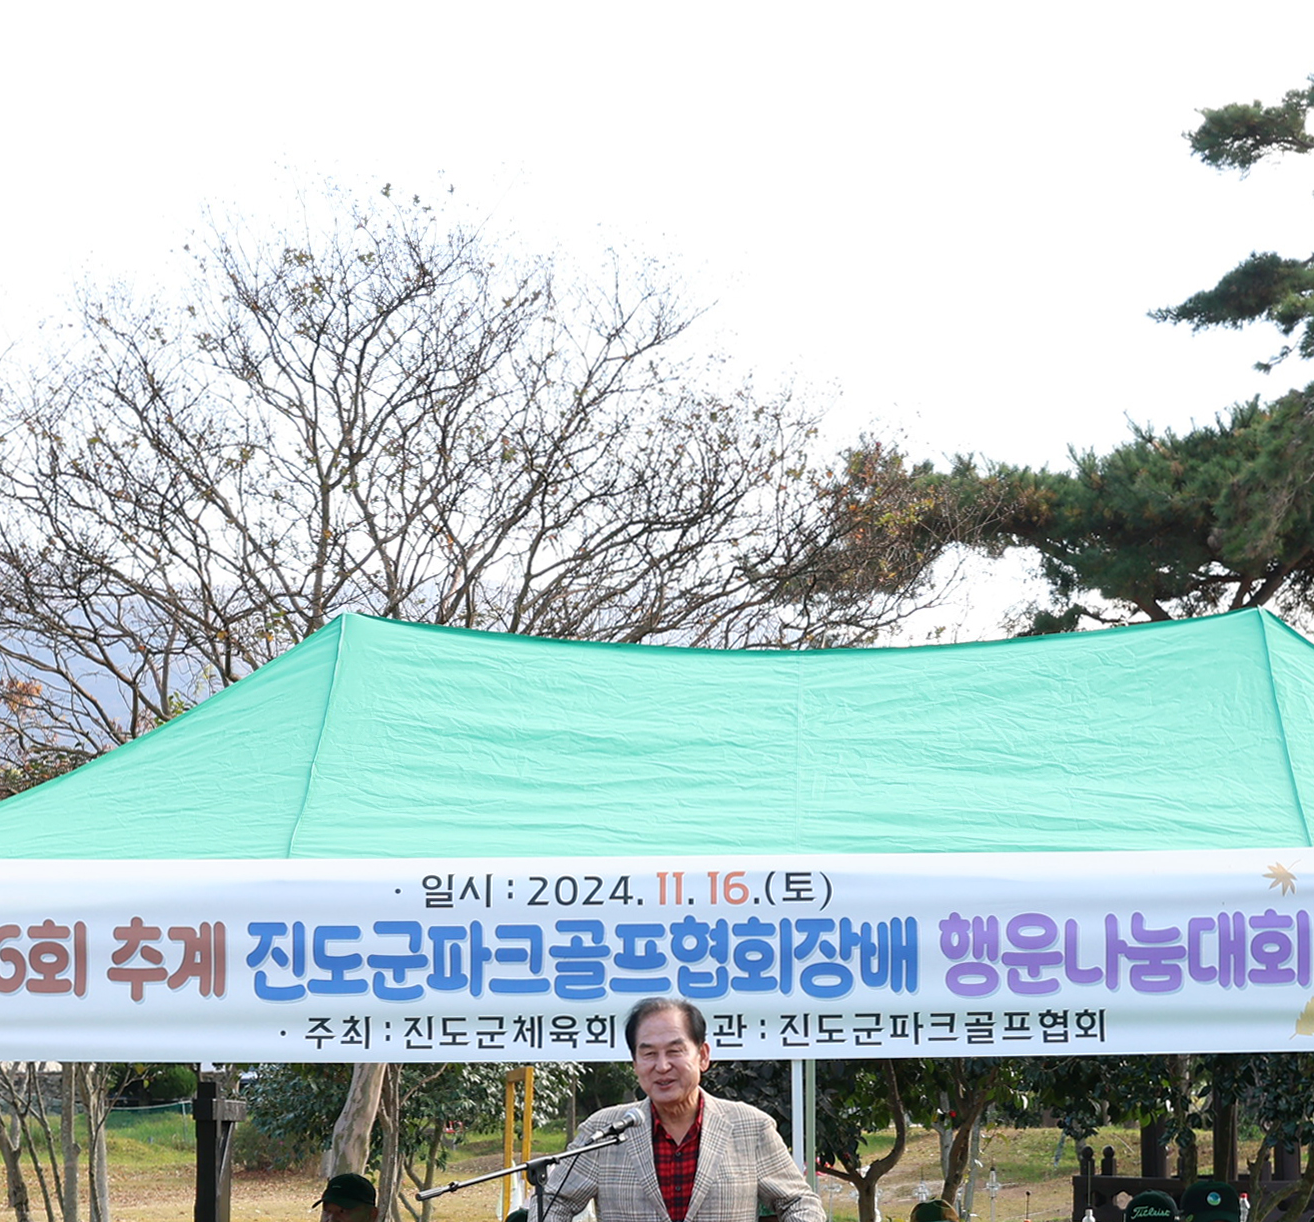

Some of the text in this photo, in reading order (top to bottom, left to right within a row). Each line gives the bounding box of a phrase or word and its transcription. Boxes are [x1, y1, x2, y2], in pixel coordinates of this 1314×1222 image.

[106, 916, 226, 1002] 추계
[246, 914, 919, 1001] 진도군파크골프협회장배
[938, 909, 1312, 997] 행운나눔대회
[403, 1014, 618, 1052] 진도군체육회
[779, 1007, 1107, 1049] 진도군파크골프협회
[1130, 1205, 1172, 1220] Titleist
